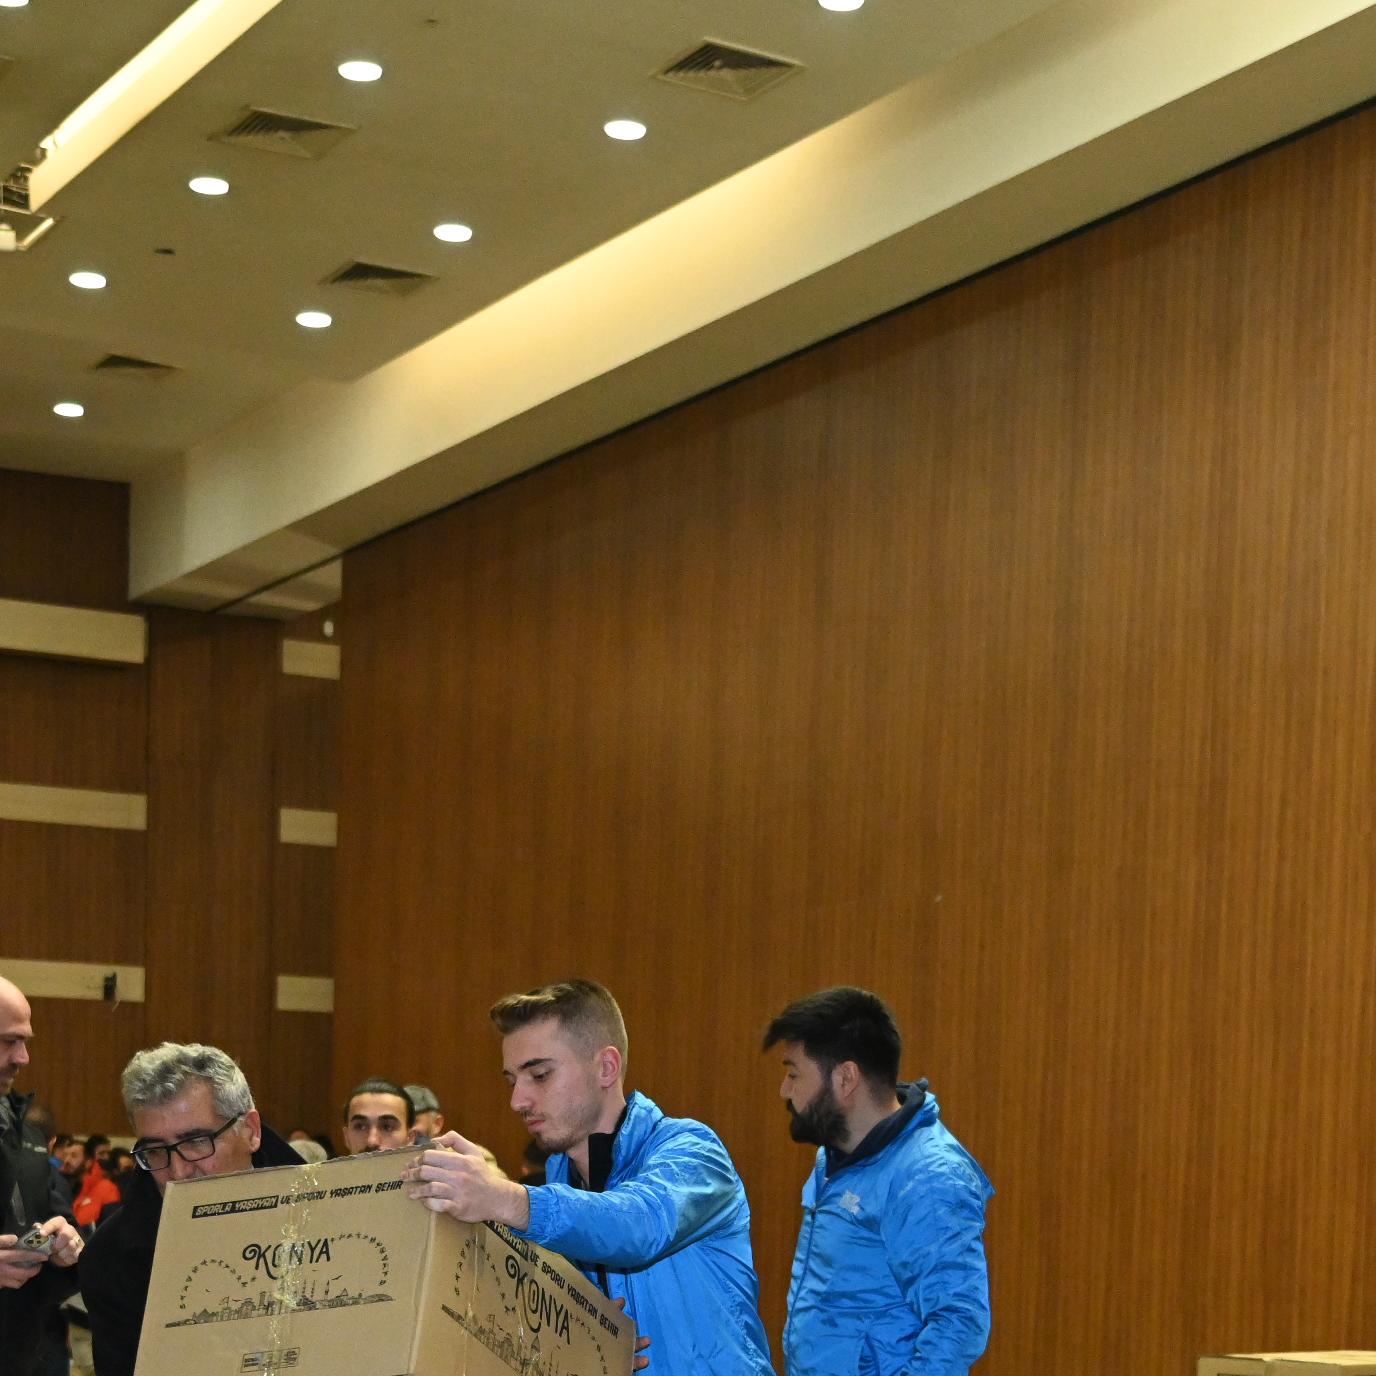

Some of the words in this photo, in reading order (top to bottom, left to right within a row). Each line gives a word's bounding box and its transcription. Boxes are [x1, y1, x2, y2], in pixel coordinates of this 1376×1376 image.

[195, 1205, 232, 1216] SPORLA
[235, 1197, 276, 1212] YAŞAYAN
[329, 1185, 372, 1199] YAŞATAN
[506, 1255, 571, 1345] KONYA
[542, 1262, 565, 1289] SPORU
[567, 1283, 598, 1319] YAŞATAN
